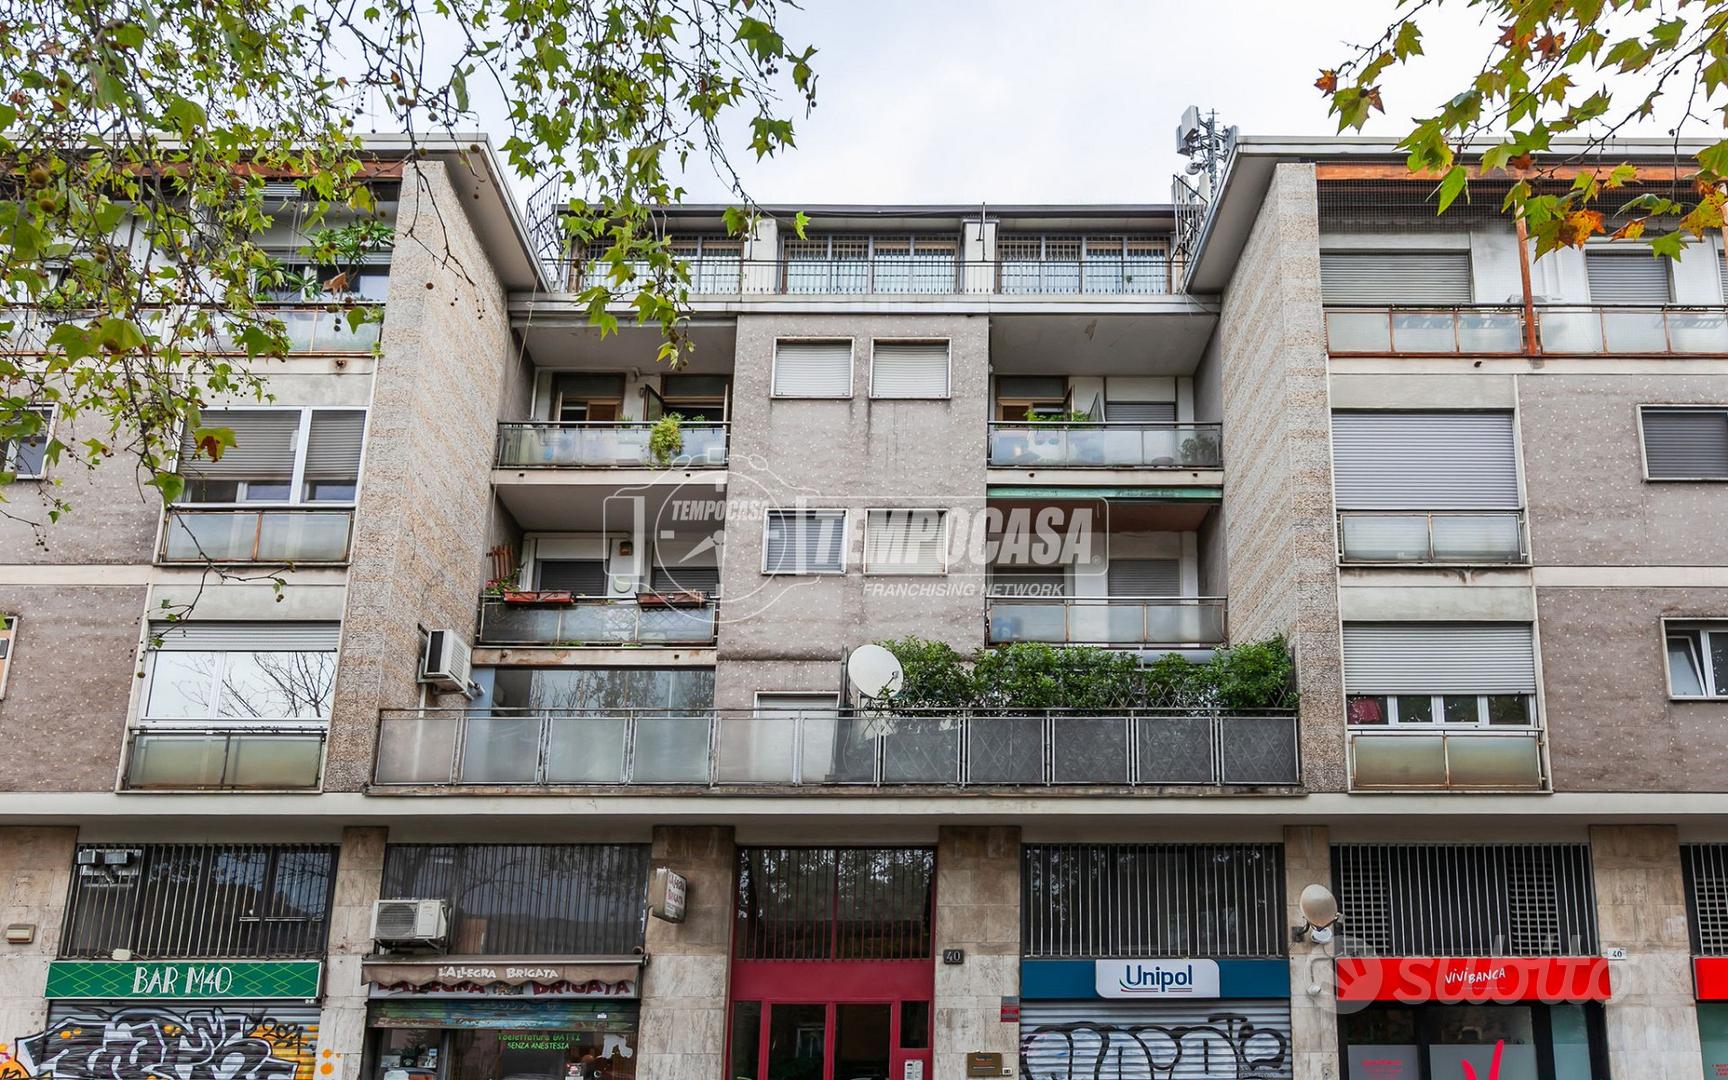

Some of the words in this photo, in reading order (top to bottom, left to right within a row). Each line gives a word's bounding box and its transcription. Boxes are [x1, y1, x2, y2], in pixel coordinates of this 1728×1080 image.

[946, 951, 961, 961] 40
[1613, 950, 1623, 958] 40
[438, 966, 497, 979] L'ALLEGRA
[505, 967, 559, 979] BRIGATA
[132, 966, 179, 994] BAR
[185, 966, 233, 994] M40
[1126, 964, 1193, 993] Unipol
[507, 1041, 529, 1049] SENZA
[531, 1042, 570, 1050] ANESTESIA
